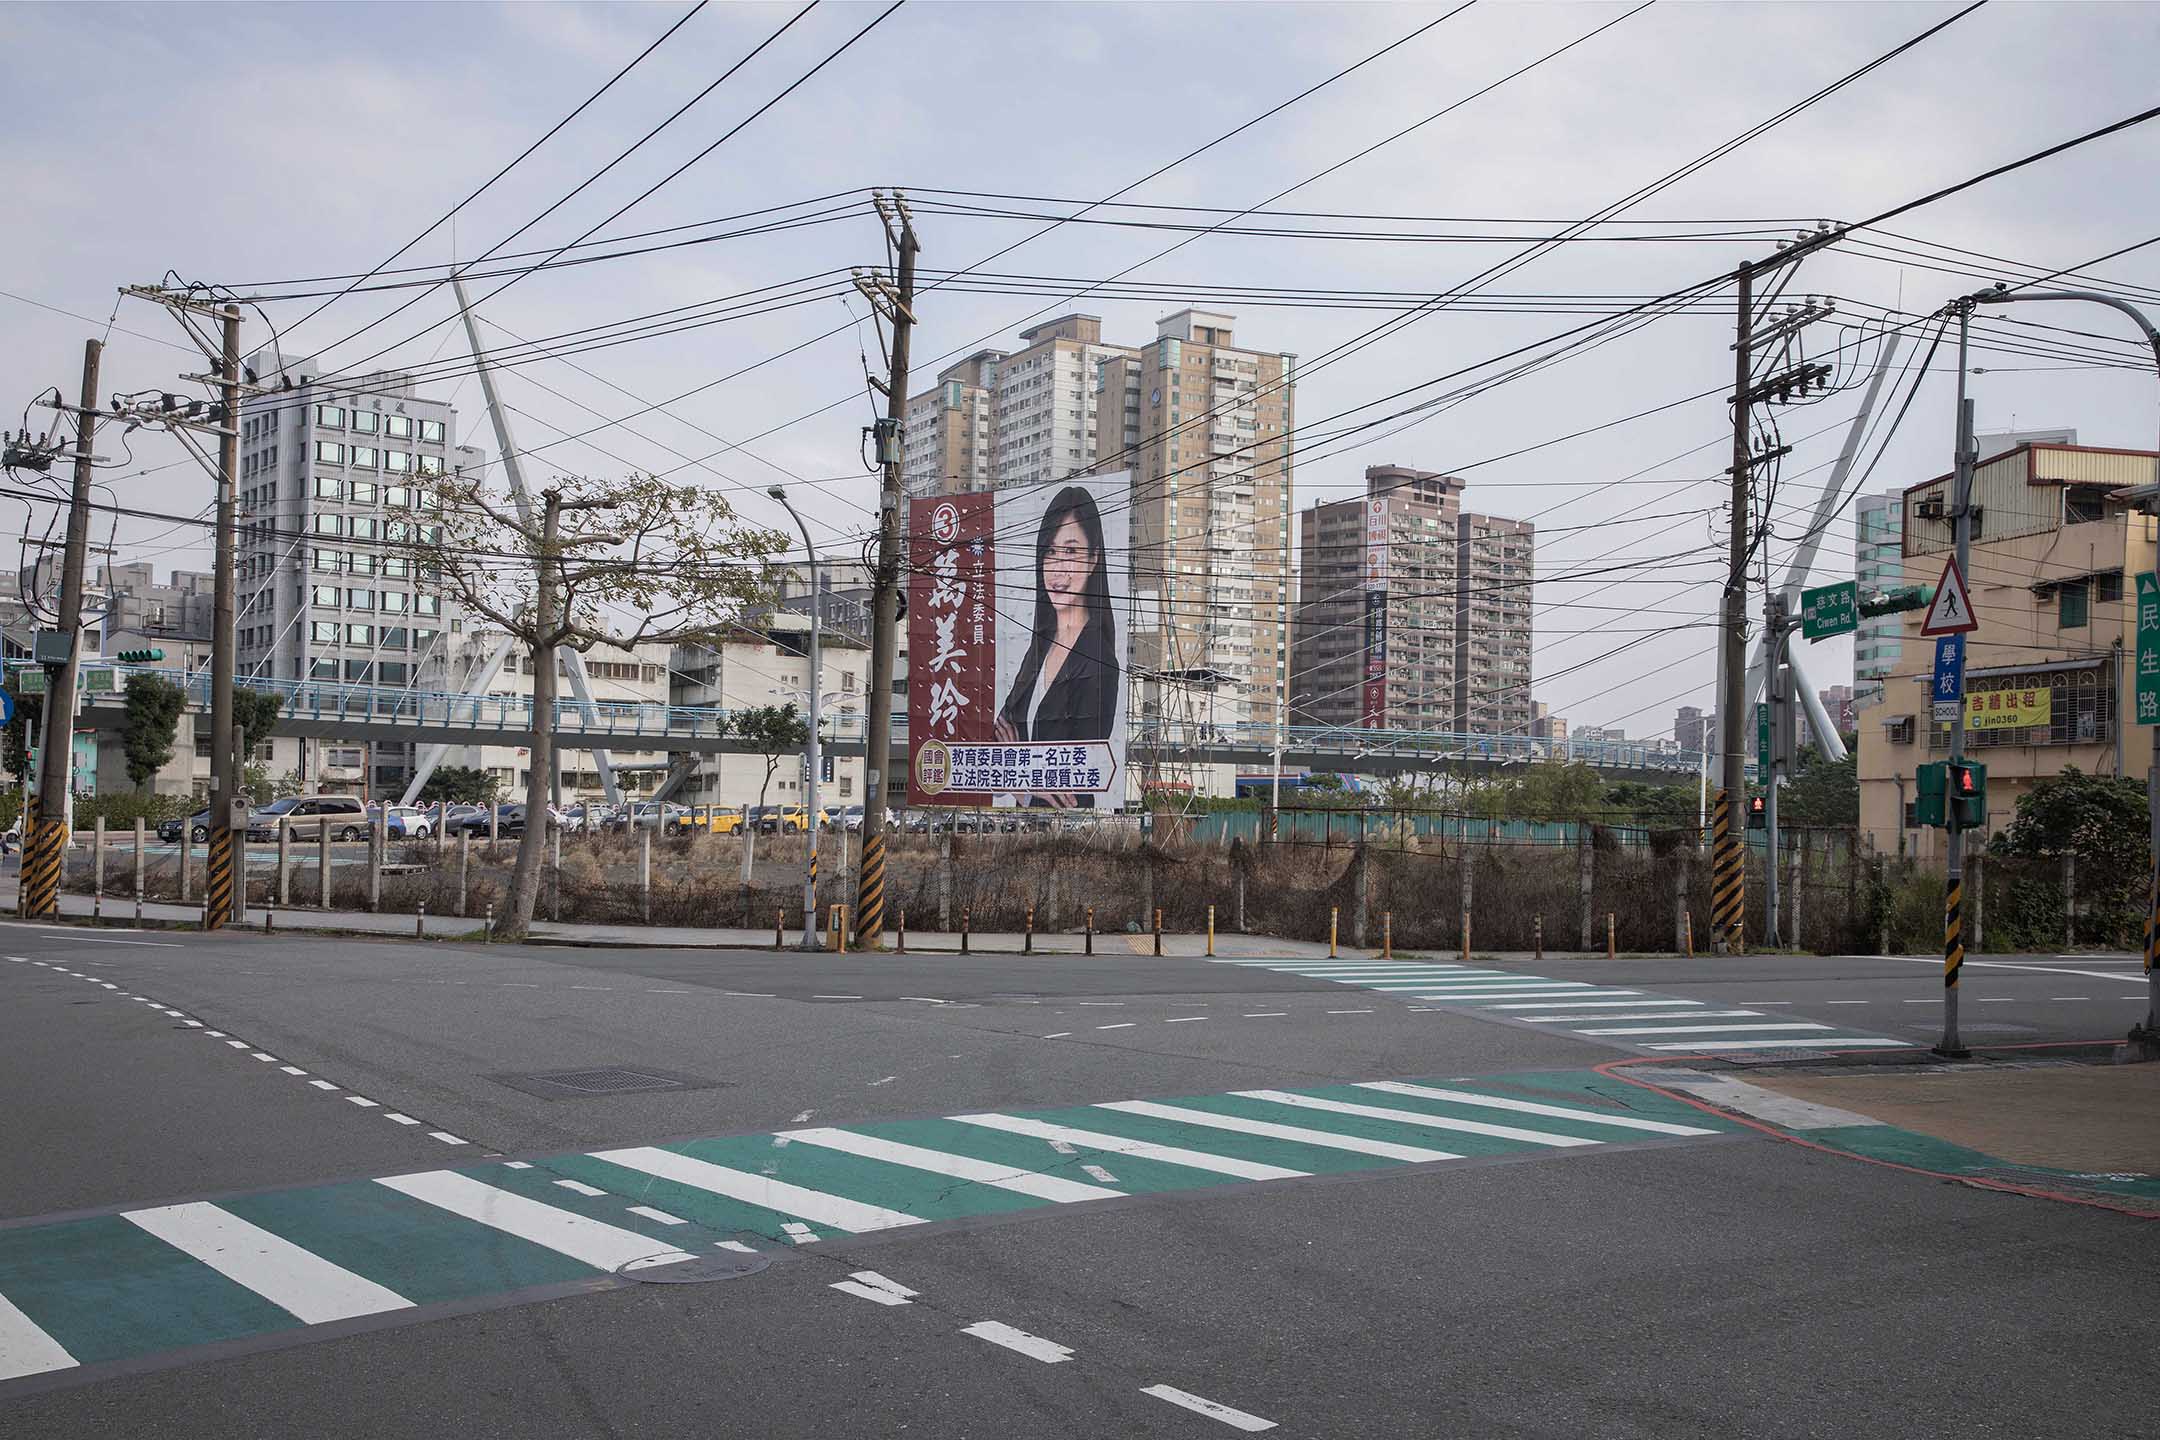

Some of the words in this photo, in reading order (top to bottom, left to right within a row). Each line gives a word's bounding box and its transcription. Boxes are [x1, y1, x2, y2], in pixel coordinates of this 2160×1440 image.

[937, 508, 955, 539] 3
[972, 560, 985, 645] 立法委員
[1816, 590, 1850, 610] 慈文路
[1816, 616, 1838, 629] Ciwen
[1840, 612, 1852, 625] Rd.
[928, 548, 970, 735] 萬美玲
[1939, 644, 1956, 694] 學校
[2139, 604, 2160, 718] 民生路
[1935, 707, 1958, 717] SCHOOL
[1965, 691, 2036, 712] 告牆出租
[1984, 714, 2018, 727] jin0360
[923, 749, 944, 764] 國會
[952, 746, 1087, 767] 教育委員會第一名立委
[951, 768, 1100, 788] 立法院全院六星優質立委
